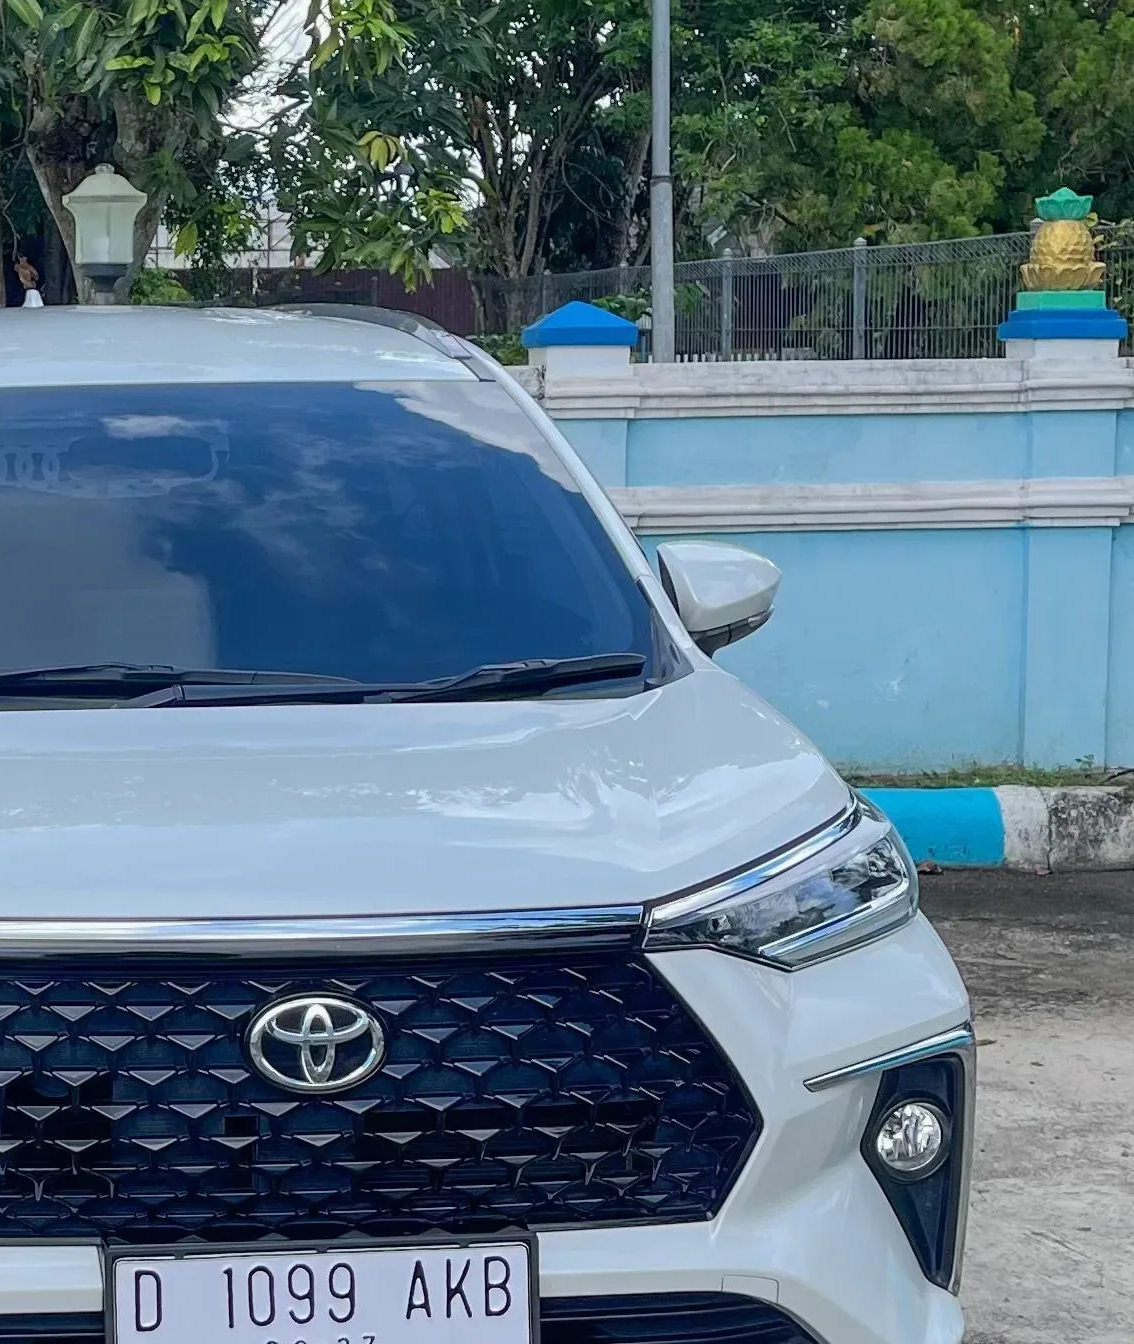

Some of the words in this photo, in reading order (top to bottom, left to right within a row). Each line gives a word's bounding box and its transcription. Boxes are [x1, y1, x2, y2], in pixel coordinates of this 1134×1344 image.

[134, 1269, 162, 1332] D
[222, 1262, 356, 1329] 1099
[405, 1255, 512, 1320] AKB
